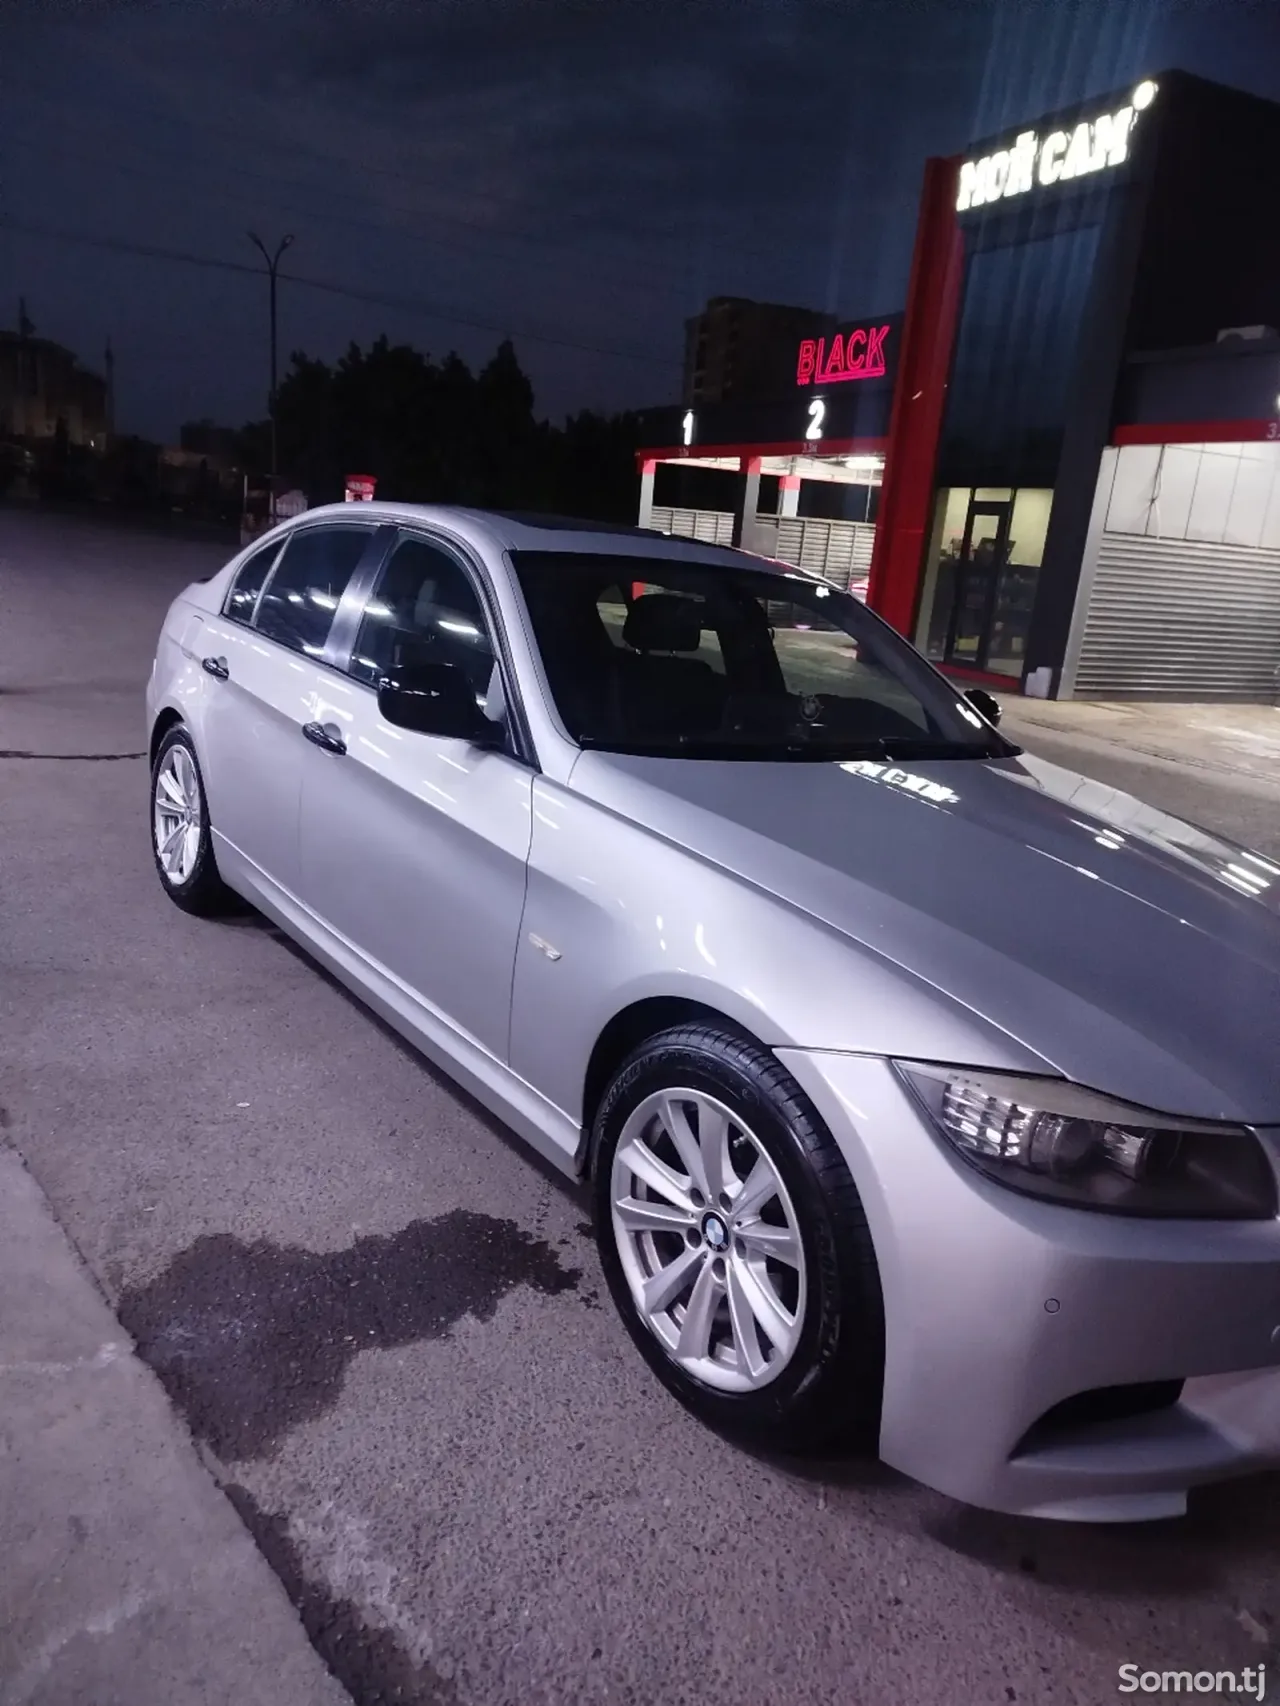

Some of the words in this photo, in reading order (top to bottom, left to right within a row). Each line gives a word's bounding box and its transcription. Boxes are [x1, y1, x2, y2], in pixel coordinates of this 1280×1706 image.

[797, 325, 889, 384] BLACK
[683, 411, 694, 446] 1
[805, 399, 825, 440] 2
